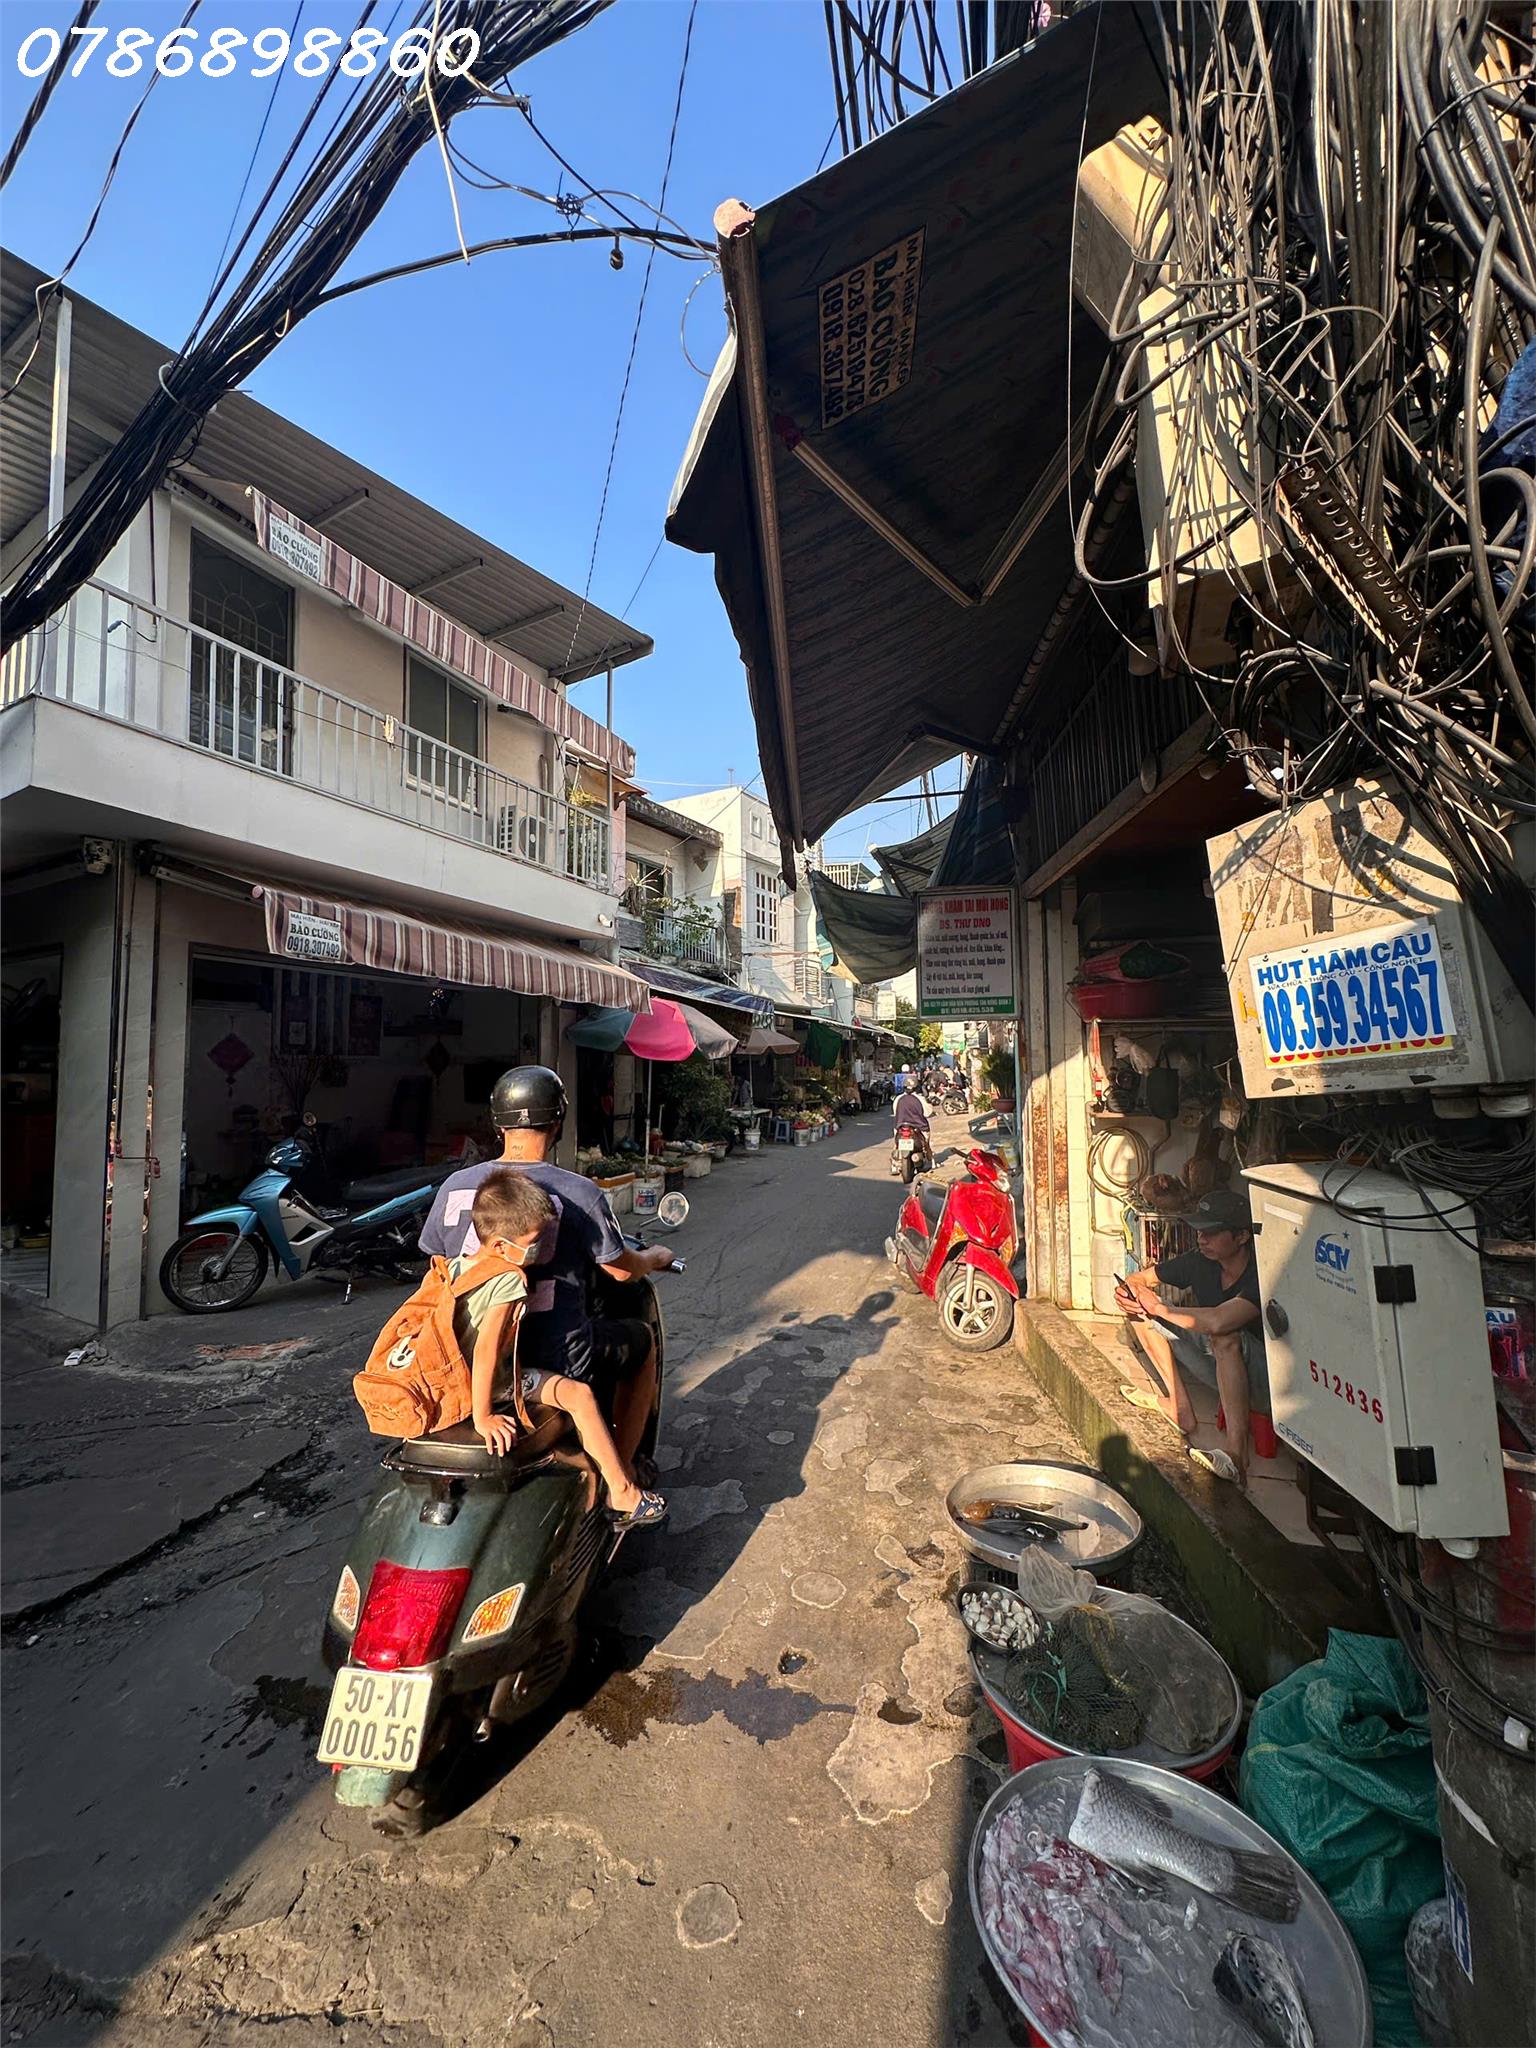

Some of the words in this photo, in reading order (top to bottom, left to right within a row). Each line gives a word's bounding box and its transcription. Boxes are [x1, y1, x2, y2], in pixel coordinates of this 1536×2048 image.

[287, 936, 340, 958] 0918.307492
[290, 921, 310, 936] BẢO
[1263, 960, 1444, 1053] 08.359.34567
[1309, 1359, 1384, 1424] 512836
[344, 1675, 415, 1719] 50-X1
[326, 1716, 417, 1763] 000.56
